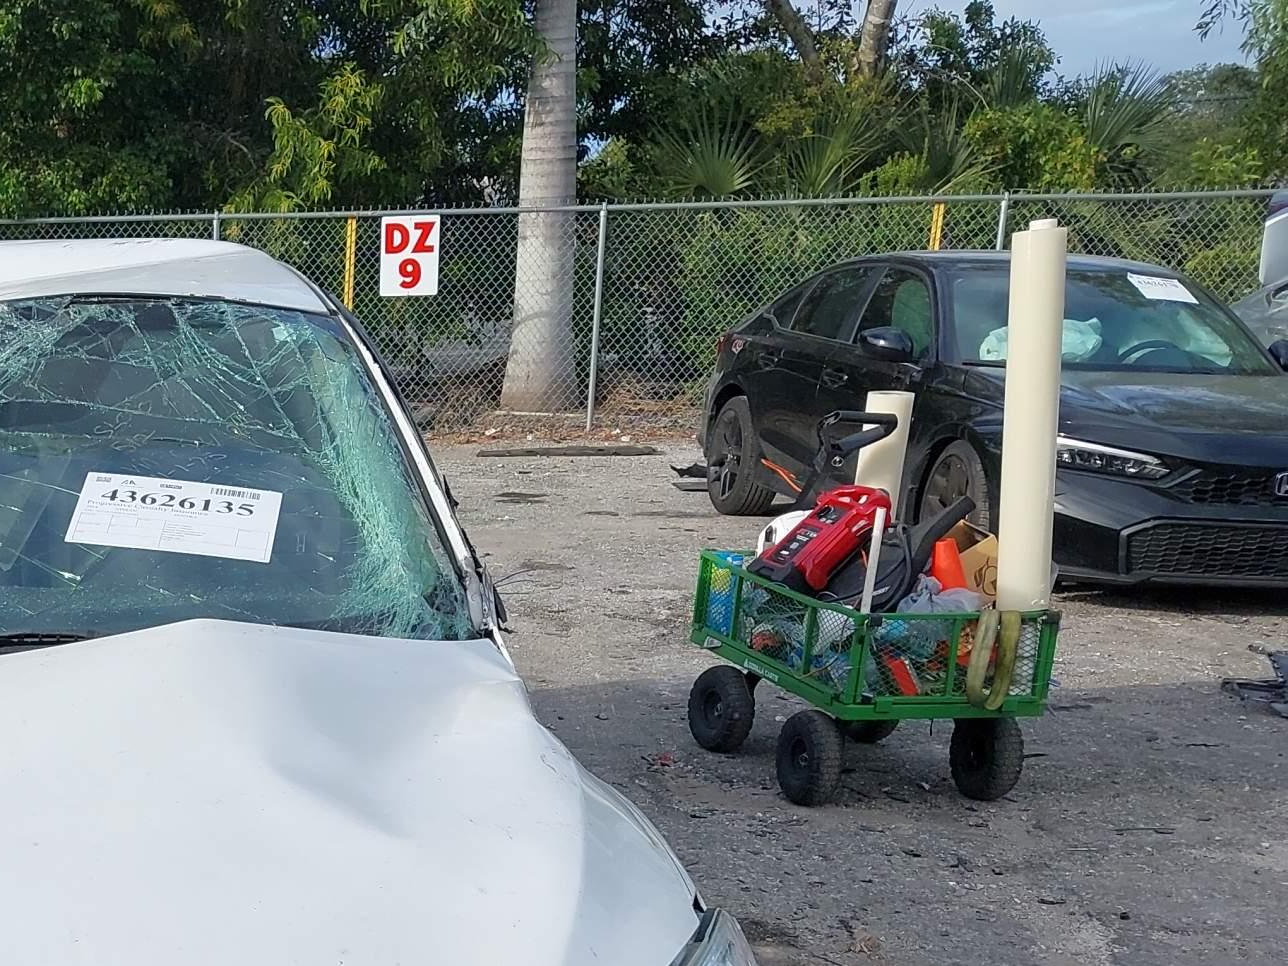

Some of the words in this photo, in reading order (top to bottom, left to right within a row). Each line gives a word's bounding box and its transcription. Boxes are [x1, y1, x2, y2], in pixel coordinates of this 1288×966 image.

[385, 221, 436, 254] DZ
[398, 258, 422, 289] 9
[101, 488, 256, 517] 43626135
